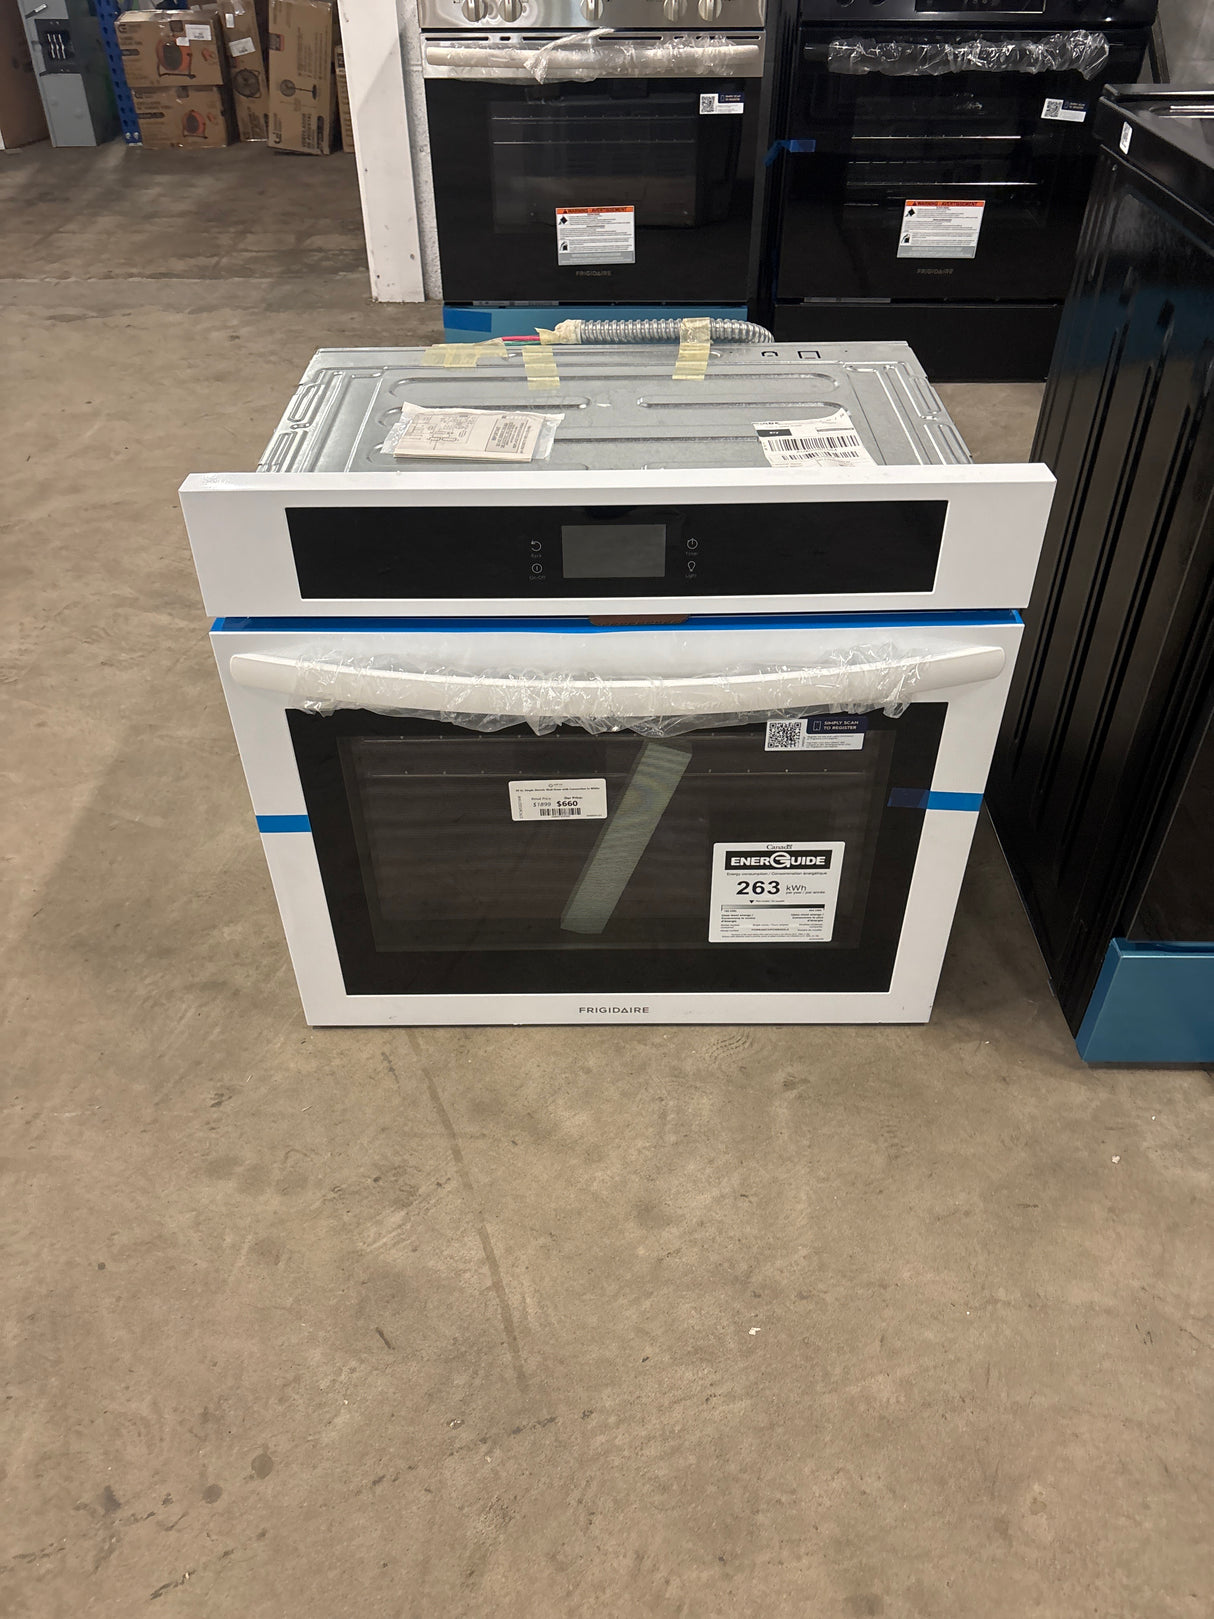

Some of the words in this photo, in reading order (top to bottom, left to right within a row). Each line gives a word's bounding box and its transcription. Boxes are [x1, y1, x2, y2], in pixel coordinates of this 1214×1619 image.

[730, 851, 826, 868] ENERGUIDE
[736, 880, 781, 896] 263
[785, 884, 807, 892] kWh
[579, 1006, 649, 1014] FRIGIDAIRE
